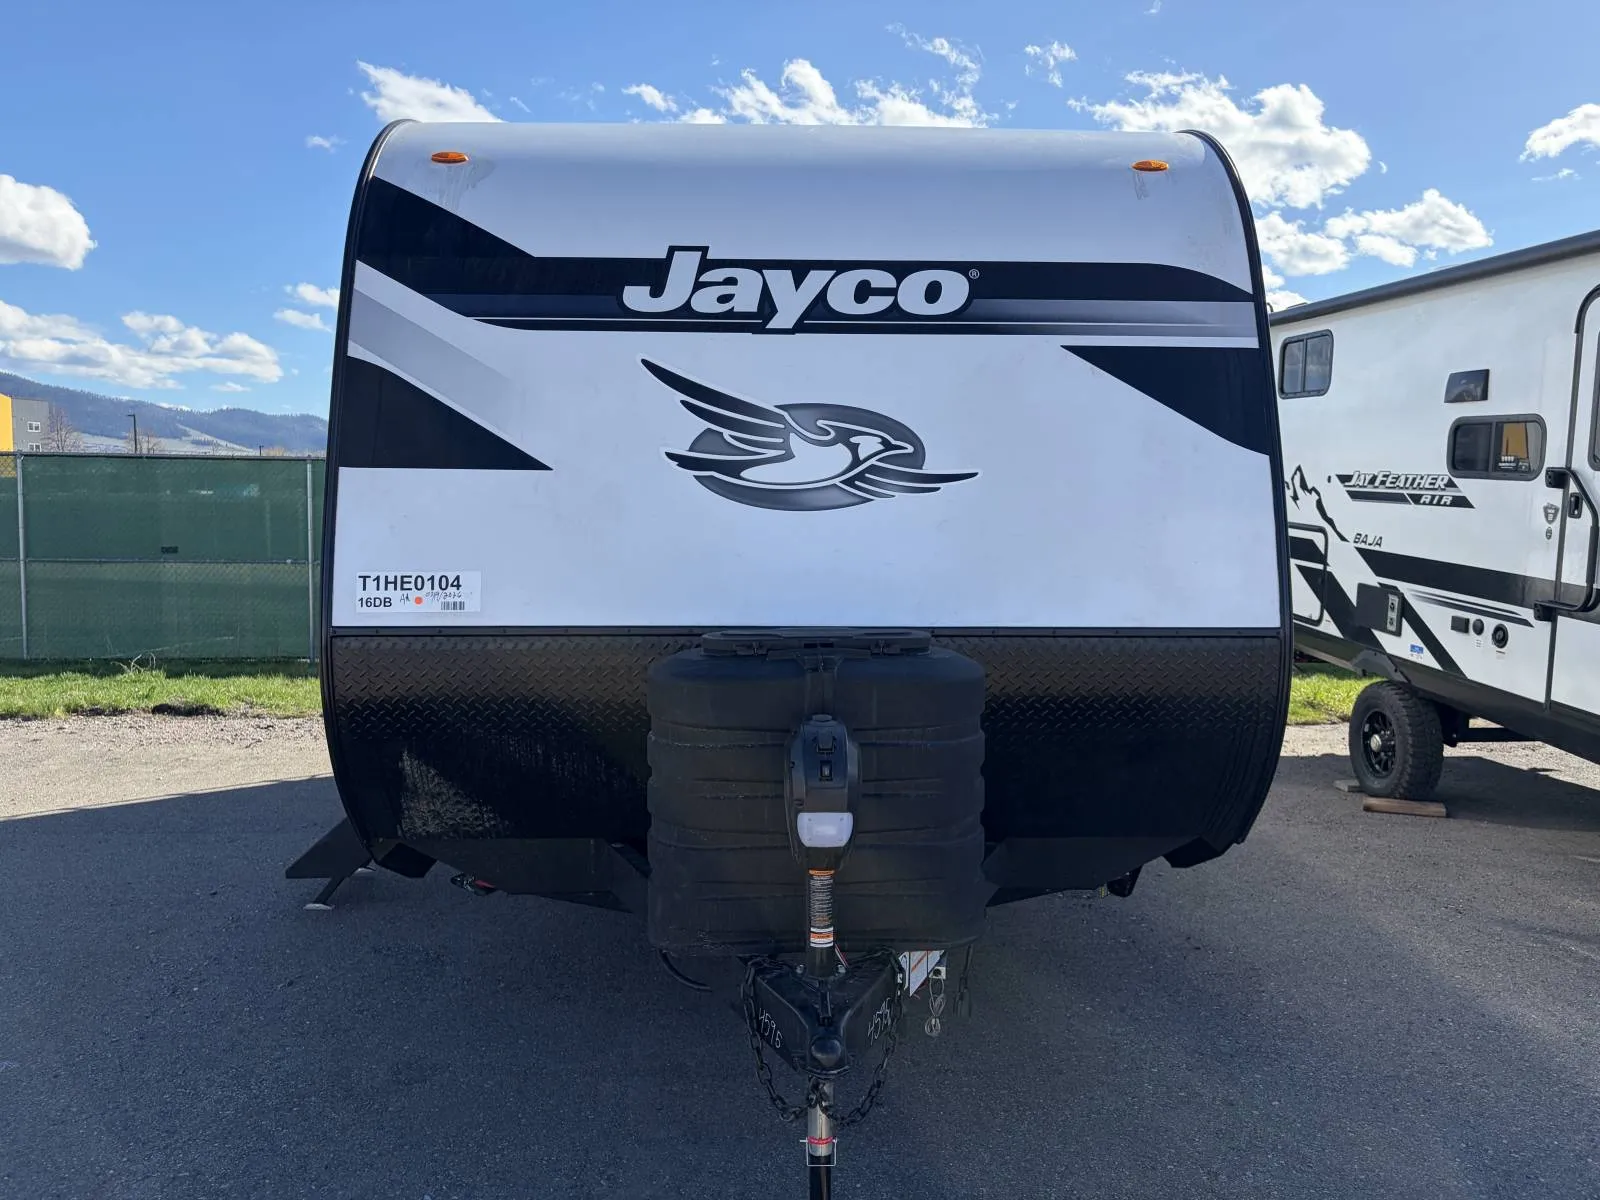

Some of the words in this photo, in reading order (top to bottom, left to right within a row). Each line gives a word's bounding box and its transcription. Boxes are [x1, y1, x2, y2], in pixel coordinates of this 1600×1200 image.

[622, 250, 970, 329] Jayco
[1344, 471, 1375, 488] JAY
[1374, 471, 1450, 490] FEATHER
[1419, 494, 1453, 506] AIR
[1353, 532, 1384, 548] BAJA
[358, 575, 461, 591] T1HE0104
[358, 597, 392, 608] 16DB
